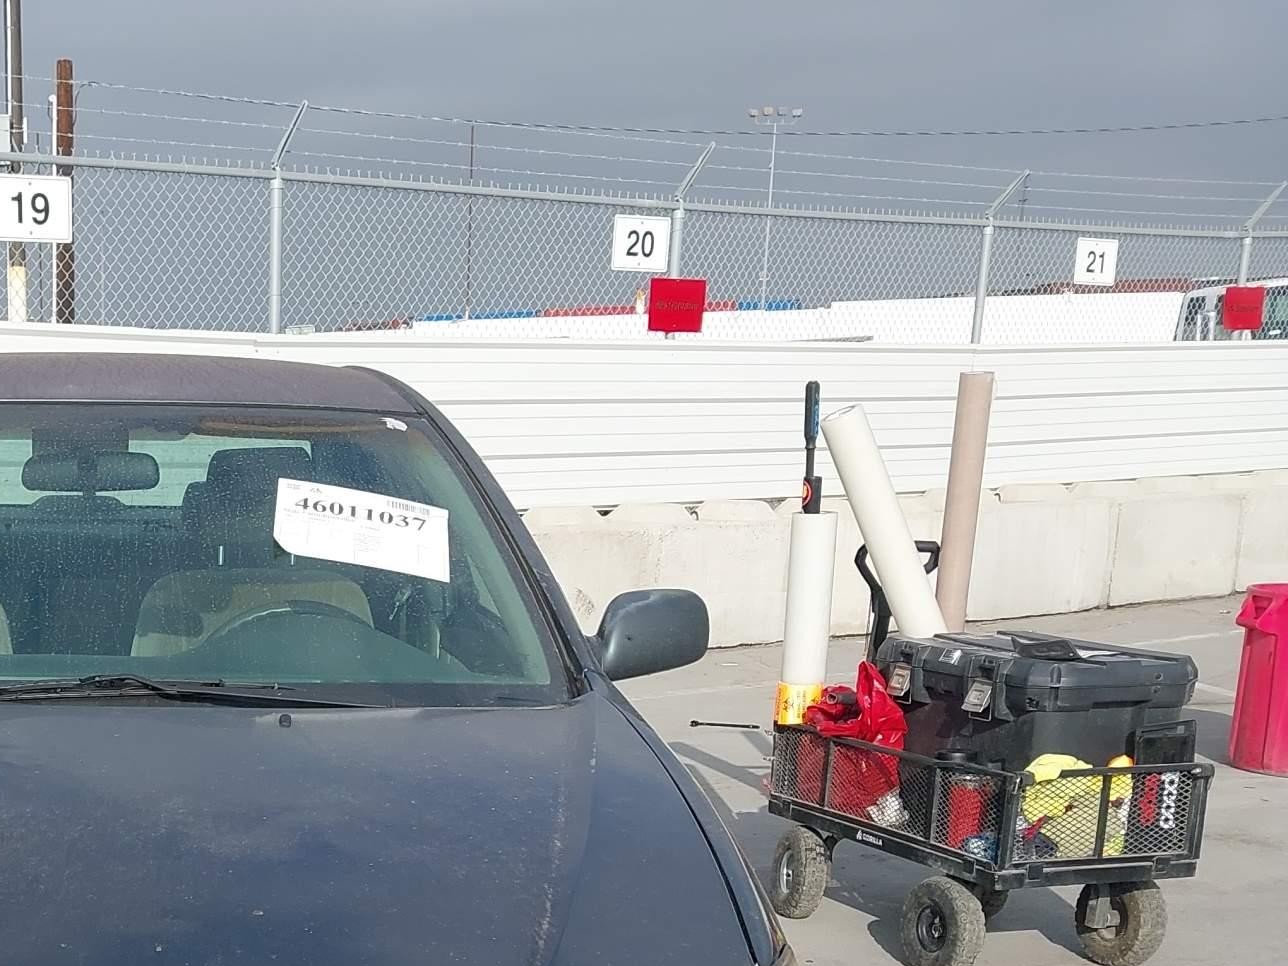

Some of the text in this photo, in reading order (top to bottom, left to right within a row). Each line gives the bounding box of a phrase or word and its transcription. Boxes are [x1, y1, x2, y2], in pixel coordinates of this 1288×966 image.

[11, 191, 50, 225] 19
[625, 228, 655, 258] 20
[1086, 250, 1106, 274] 21
[294, 497, 427, 531] 46011037
